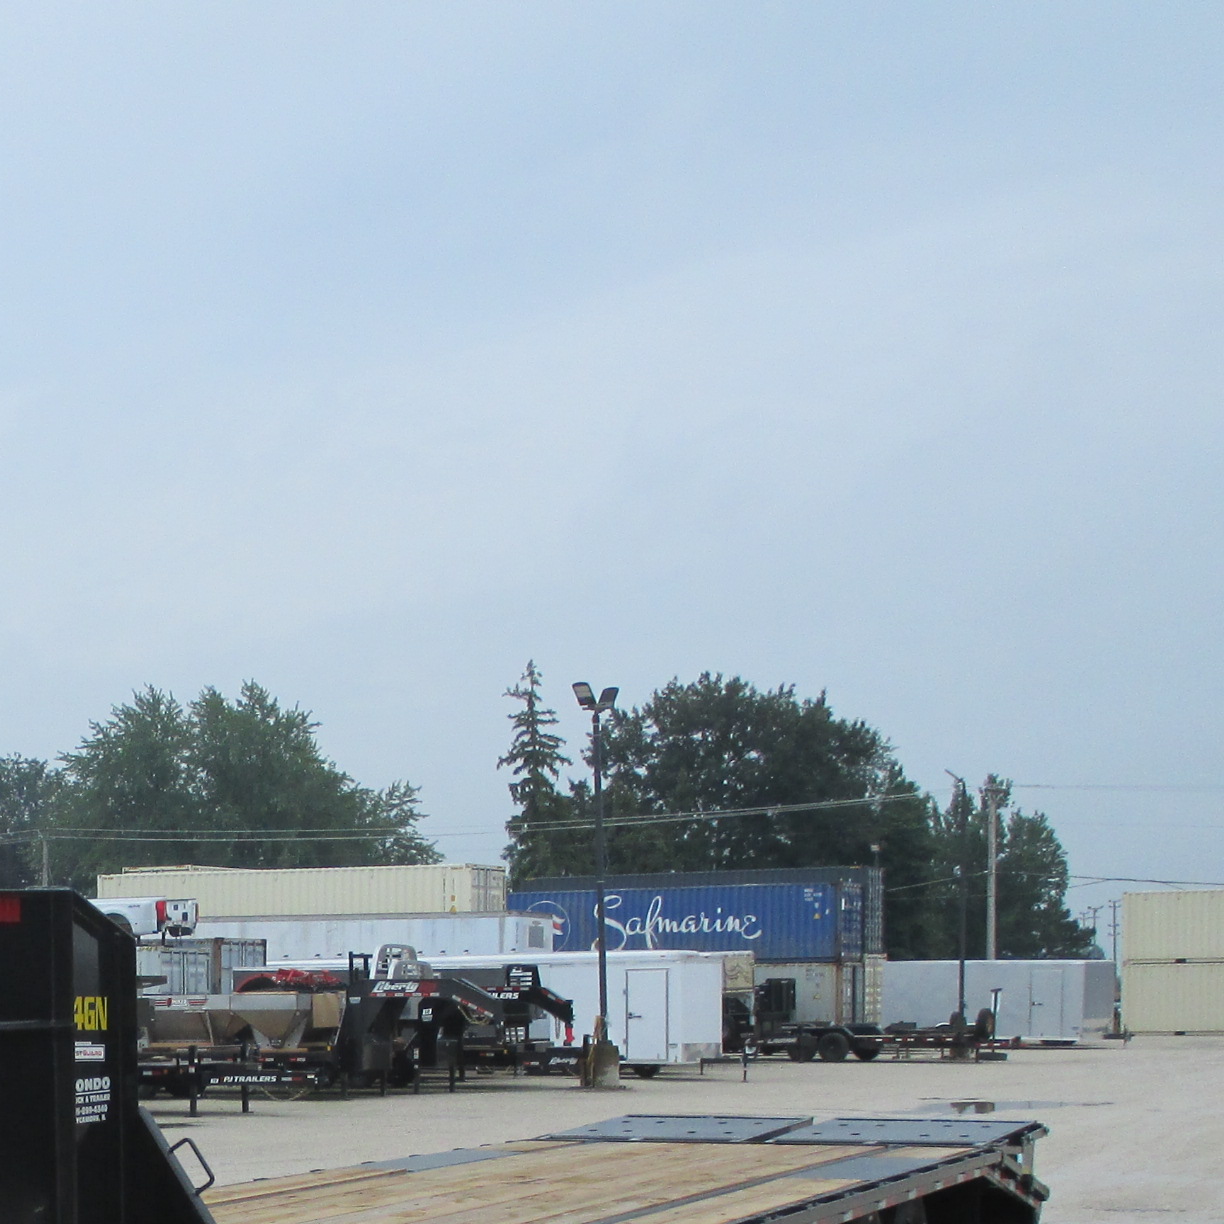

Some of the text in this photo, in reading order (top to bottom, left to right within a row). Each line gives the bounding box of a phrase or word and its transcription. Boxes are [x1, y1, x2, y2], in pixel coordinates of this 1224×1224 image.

[591, 895, 762, 950] Safmarine
[371, 981, 420, 993] Liberty
[489, 992, 520, 1000] ILERS
[74, 996, 108, 1030] 4GN
[75, 1077, 111, 1092] ONDO
[234, 1075, 277, 1083] TRAILERS
